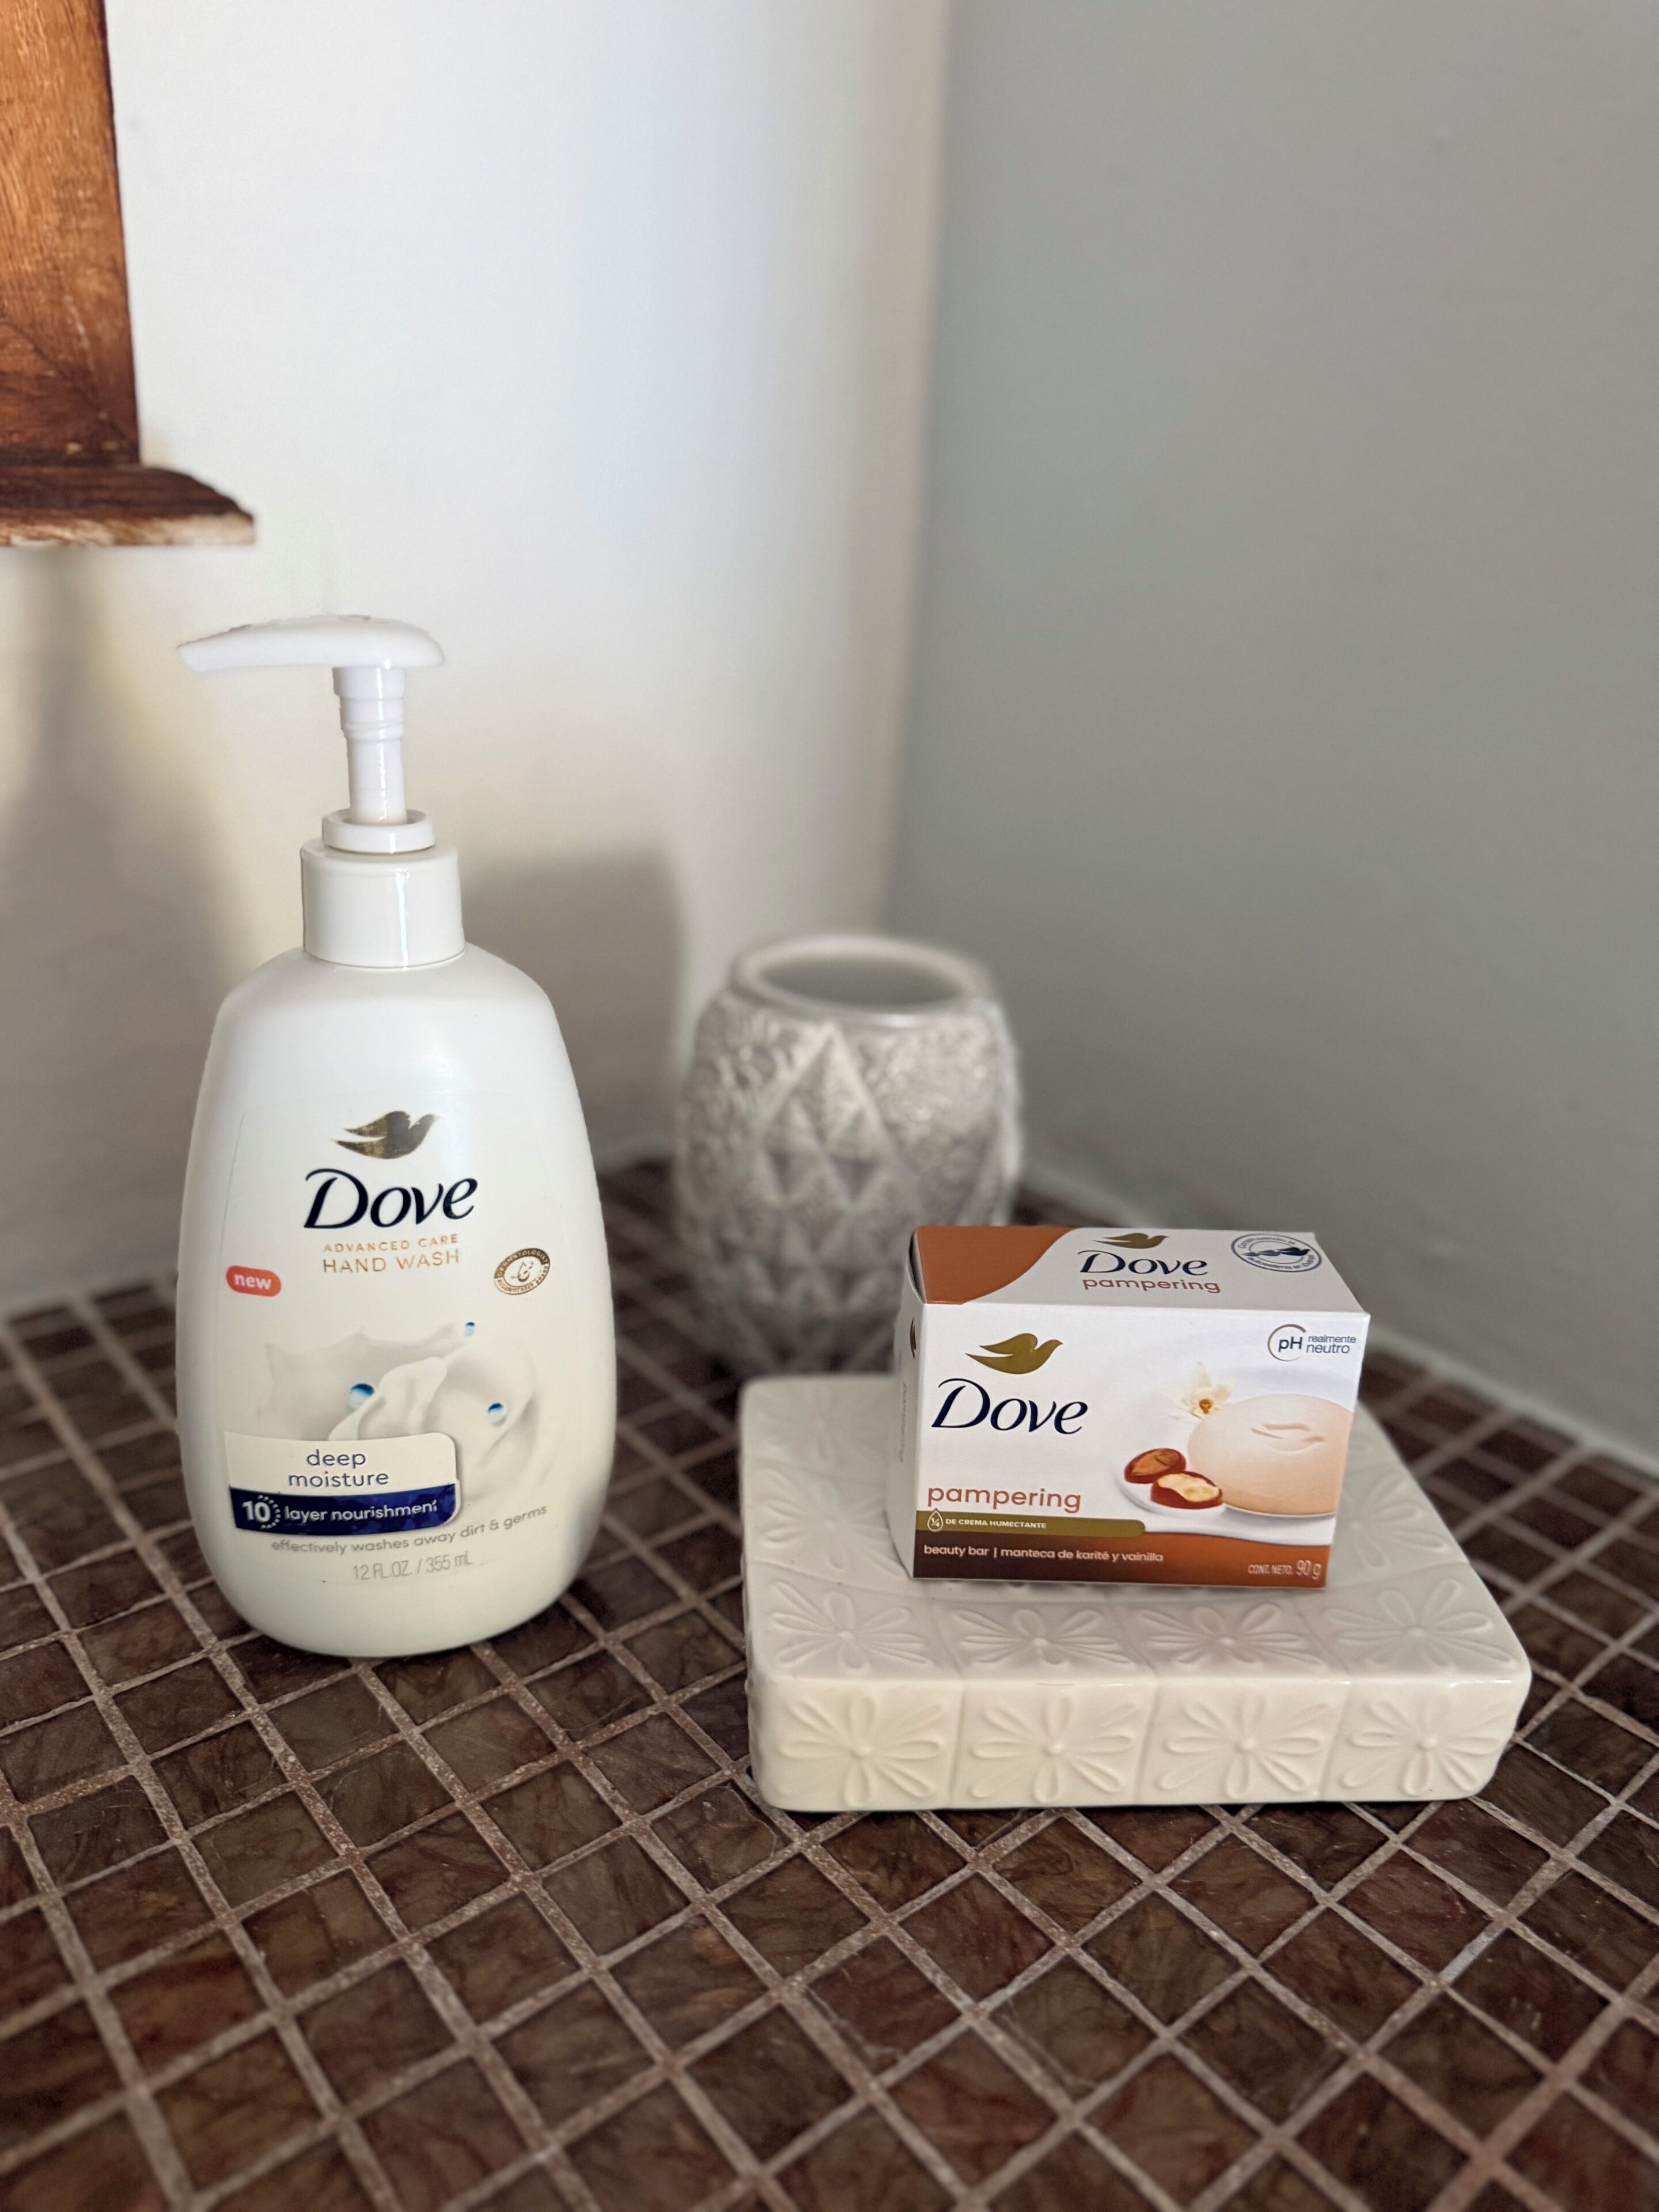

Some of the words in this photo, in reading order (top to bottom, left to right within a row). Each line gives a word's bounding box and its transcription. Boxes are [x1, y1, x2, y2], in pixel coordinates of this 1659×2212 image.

[304, 1168, 478, 1229] Dove
[323, 1240, 410, 1252] ADVANCED
[418, 1234, 459, 1248] CARE
[323, 1257, 387, 1273] HAND
[396, 1249, 460, 1270] WASH
[1077, 1250, 1208, 1275] Dove
[234, 1272, 272, 1290] new
[1082, 1277, 1222, 1294] pampering
[1278, 1336, 1303, 1352] pH
[1306, 1343, 1350, 1354] neutro
[1308, 1335, 1357, 1343] realmente
[931, 1378, 1088, 1434] Dove
[306, 1449, 366, 1469] deep
[288, 1471, 389, 1488] moisture
[927, 1487, 1081, 1514] pampering
[242, 1501, 271, 1522] 10
[284, 1505, 326, 1524] layer
[272, 1540, 346, 1555] effectively
[351, 1538, 410, 1552] washes
[414, 1531, 456, 1547] away
[460, 1523, 484, 1537] dirt
[489, 1520, 500, 1531] &
[503, 1505, 547, 1531] germs
[959, 1518, 988, 1527] CREMA
[990, 1520, 1047, 1529] HUMECTANTE
[923, 1544, 966, 1557] beauty
[968, 1546, 990, 1556] bar
[1001, 1548, 1056, 1559] manteca
[1058, 1550, 1073, 1559] de
[1076, 1549, 1109, 1560] karité
[1111, 1552, 1120, 1562] y
[1122, 1551, 1164, 1562] vainilla
[353, 1565, 369, 1580] 12
[426, 1555, 450, 1573] 355
[454, 1551, 474, 1567] mL
[1296, 1559, 1312, 1576] 90
[1312, 1563, 1321, 1580] g
